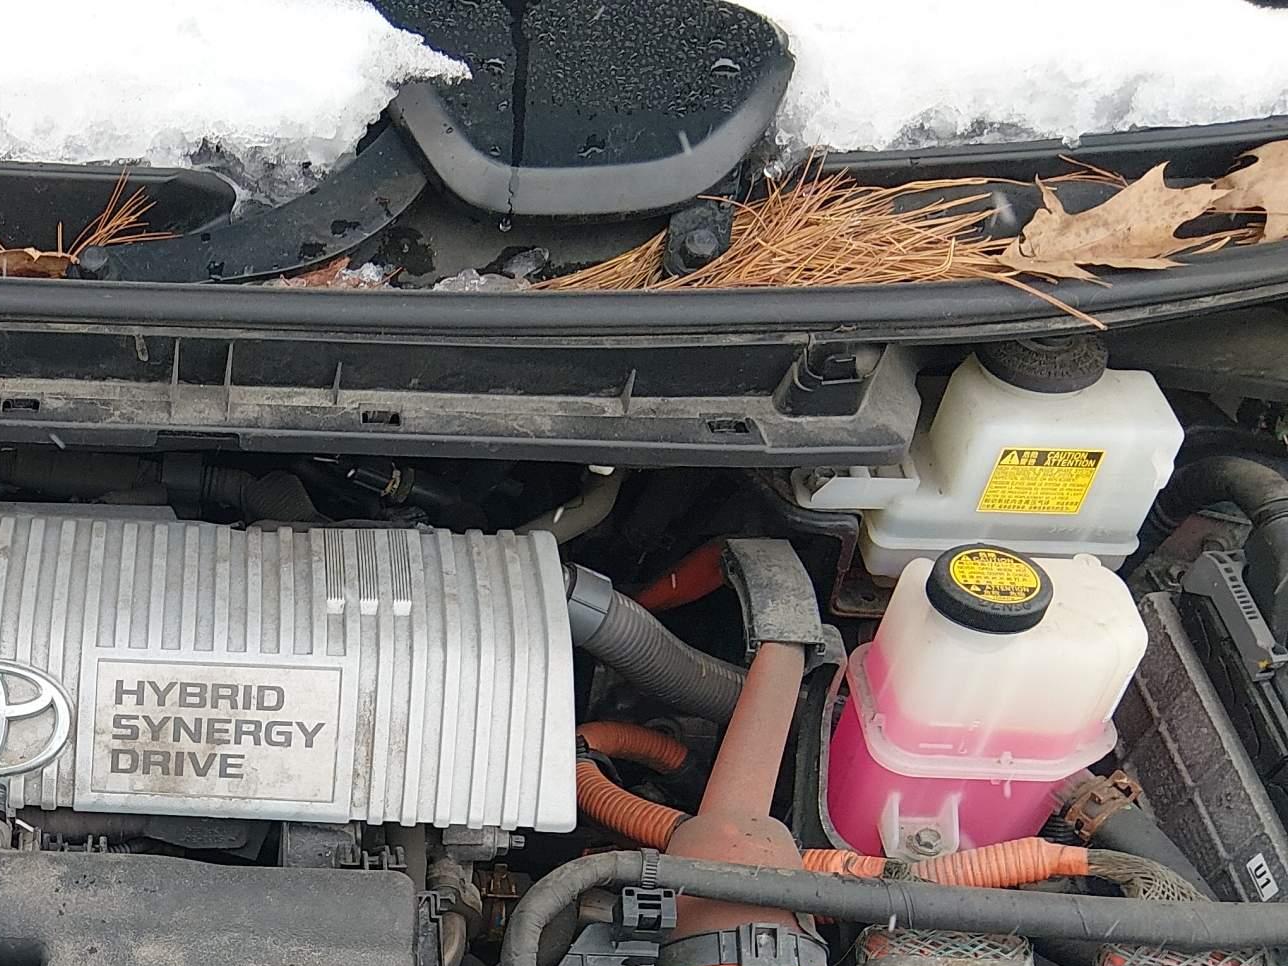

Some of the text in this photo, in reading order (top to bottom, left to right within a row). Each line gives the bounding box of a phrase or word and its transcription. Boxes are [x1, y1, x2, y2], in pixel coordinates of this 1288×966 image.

[1043, 458, 1096, 467] ATTENTION
[1047, 451, 1088, 460] CAUTION
[114, 680, 285, 711] HYBRID
[112, 714, 325, 748] SYNERGY
[110, 748, 245, 779] DRIVE
[1254, 863, 1271, 889] U1
